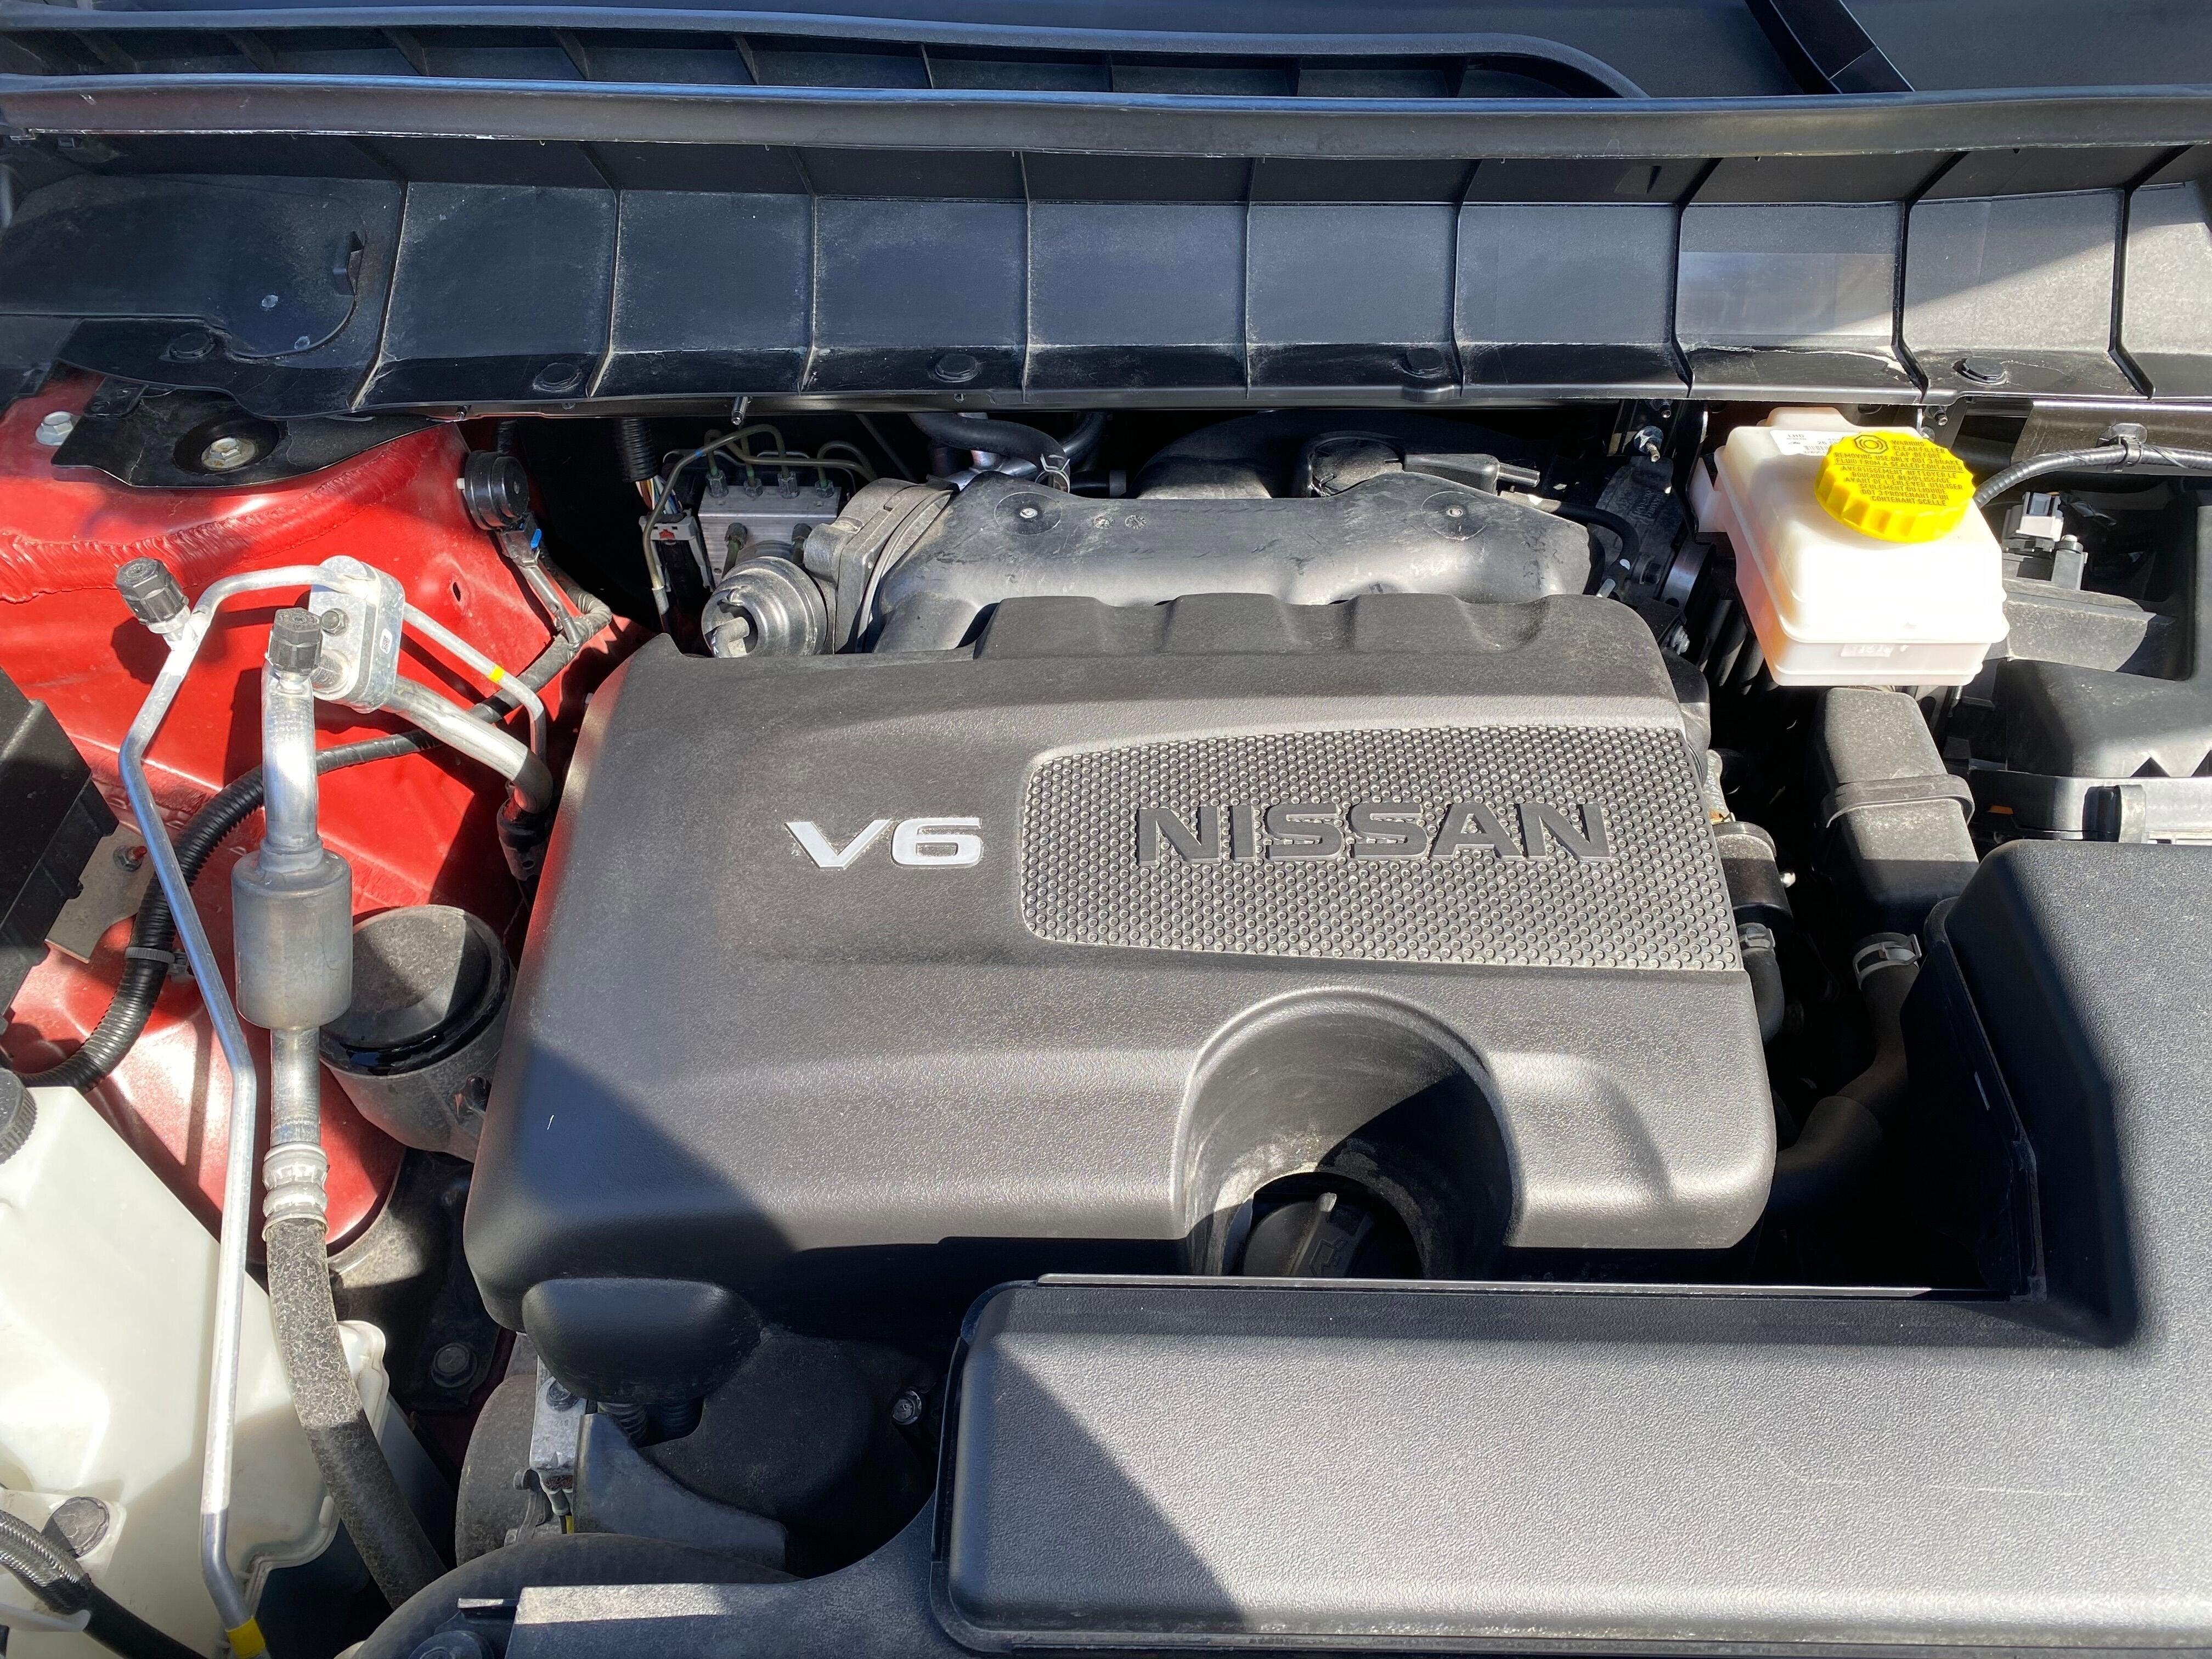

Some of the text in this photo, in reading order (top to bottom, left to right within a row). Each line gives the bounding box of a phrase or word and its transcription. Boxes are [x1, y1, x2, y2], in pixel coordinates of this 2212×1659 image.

[1898, 475, 1950, 483] REMPLISSAGE
[1860, 483, 1904, 492] SEULEMENT
[1871, 495, 1916, 504] CONTENANT
[1135, 802, 1612, 865] NISSAN
[784, 817, 982, 870] V6
